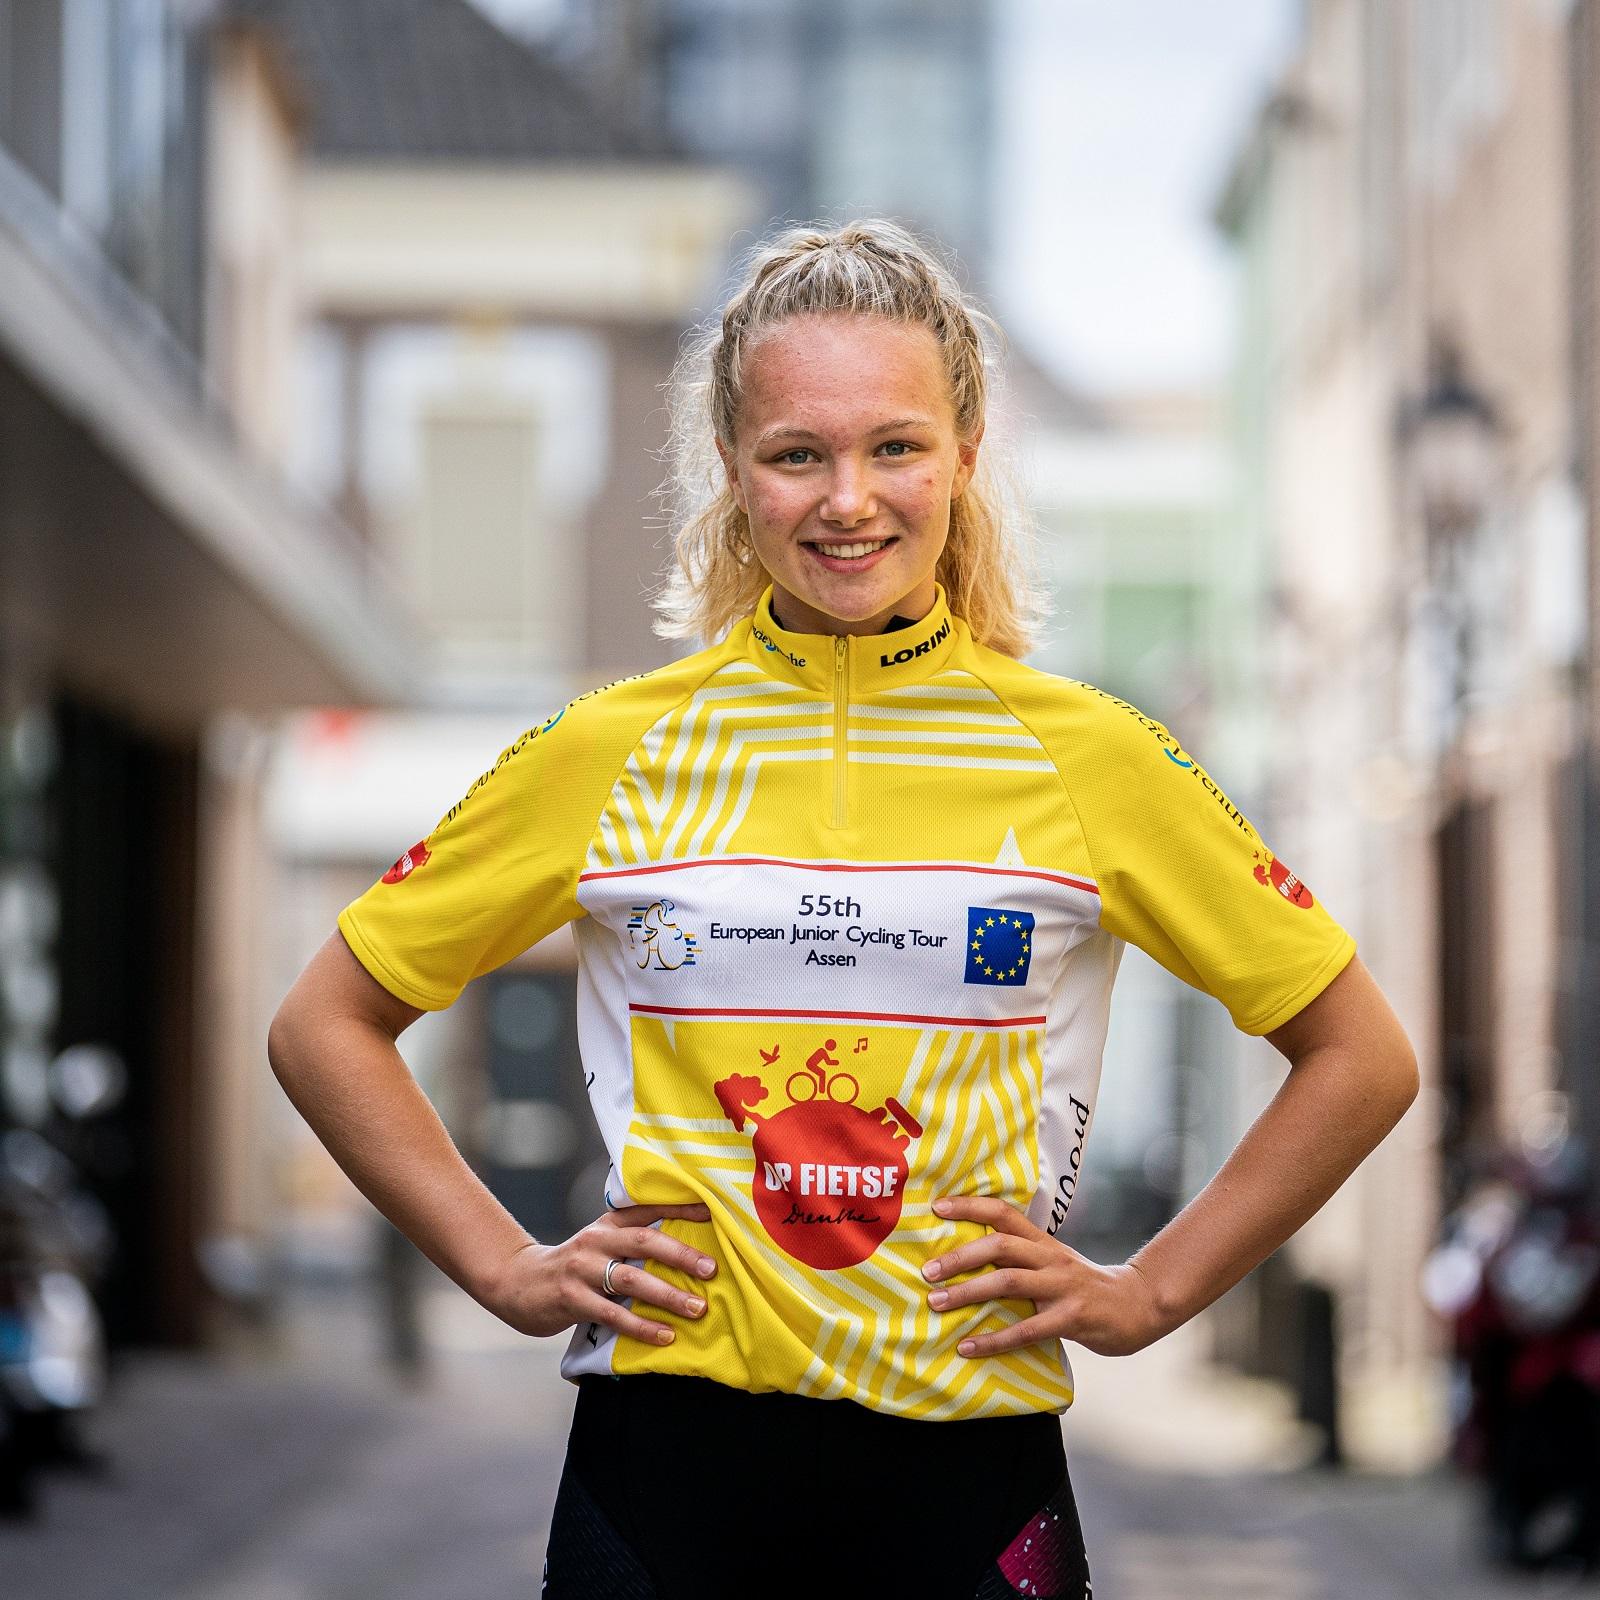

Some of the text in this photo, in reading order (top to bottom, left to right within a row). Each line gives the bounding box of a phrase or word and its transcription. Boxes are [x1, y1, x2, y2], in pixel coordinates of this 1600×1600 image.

[880, 617, 951, 668] LORINI
[798, 894, 862, 918] 55th
[710, 922, 948, 949] European Junior Cycling Tour
[805, 949, 857, 967] Assen
[800, 1162, 899, 1199] FIETSE
